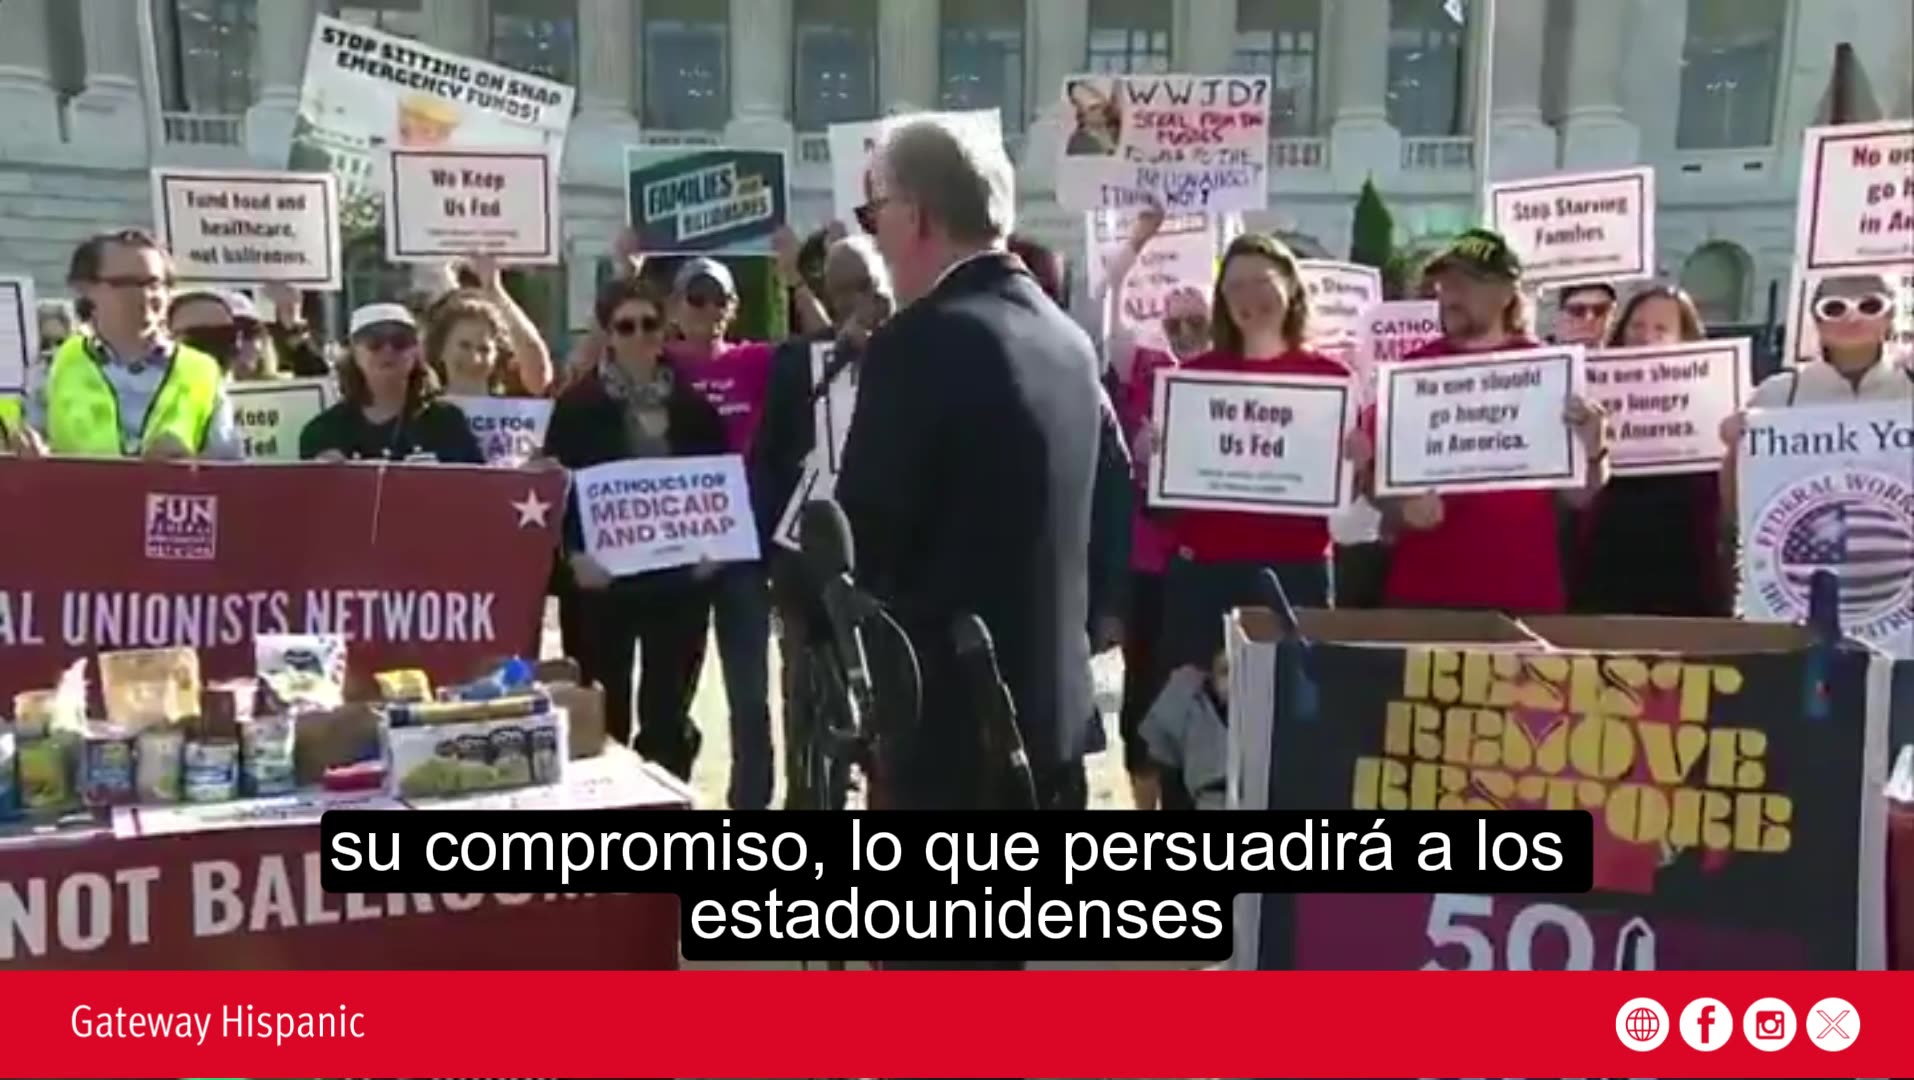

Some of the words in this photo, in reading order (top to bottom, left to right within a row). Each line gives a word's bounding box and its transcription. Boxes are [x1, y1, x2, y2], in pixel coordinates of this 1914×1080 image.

[322, 27, 377, 51] STOP
[383, 43, 471, 83] SITTING
[475, 69, 504, 93] ON
[508, 79, 562, 106] SNAP
[336, 52, 463, 98] EMERGENCY
[467, 90, 540, 122] FUNDS!
[1852, 145, 1881, 167] No
[430, 169, 457, 188] We
[461, 168, 506, 192] Keep
[186, 190, 229, 208] Fund
[232, 191, 271, 210] food
[276, 193, 306, 211] and
[444, 197, 466, 217] Us
[470, 196, 502, 217] Fed
[1555, 196, 1628, 217] Starving
[1866, 182, 1897, 206] go
[1535, 222, 1606, 249] Families
[1859, 212, 1881, 234] in
[1370, 319, 1440, 335] CATHO
[1415, 377, 1438, 396] No
[1443, 376, 1475, 394] one
[1480, 367, 1542, 391] should
[1649, 360, 1709, 382] should
[1208, 397, 1238, 421] We
[1243, 397, 1294, 428] Keep
[1429, 409, 1451, 430] go
[1455, 402, 1520, 424] hungry
[1626, 392, 1690, 413] hungry
[1219, 433, 1245, 457] Us
[1250, 434, 1285, 459] Fed
[1425, 436, 1443, 456] in
[1742, 421, 1859, 457] Thank
[587, 476, 689, 499] CATHOLICS
[690, 472, 728, 489] FOR
[147, 494, 215, 524] FUN
[590, 491, 731, 527] MEDICAID
[596, 524, 656, 549] AND
[660, 516, 736, 540] SNAP
[62, 590, 290, 648] UNIONISTS
[304, 590, 497, 642] NETWORK
[1383, 700, 1769, 789] REMOVE
[1352, 756, 1794, 853] RESTORE
[0, 866, 161, 959] NOT
